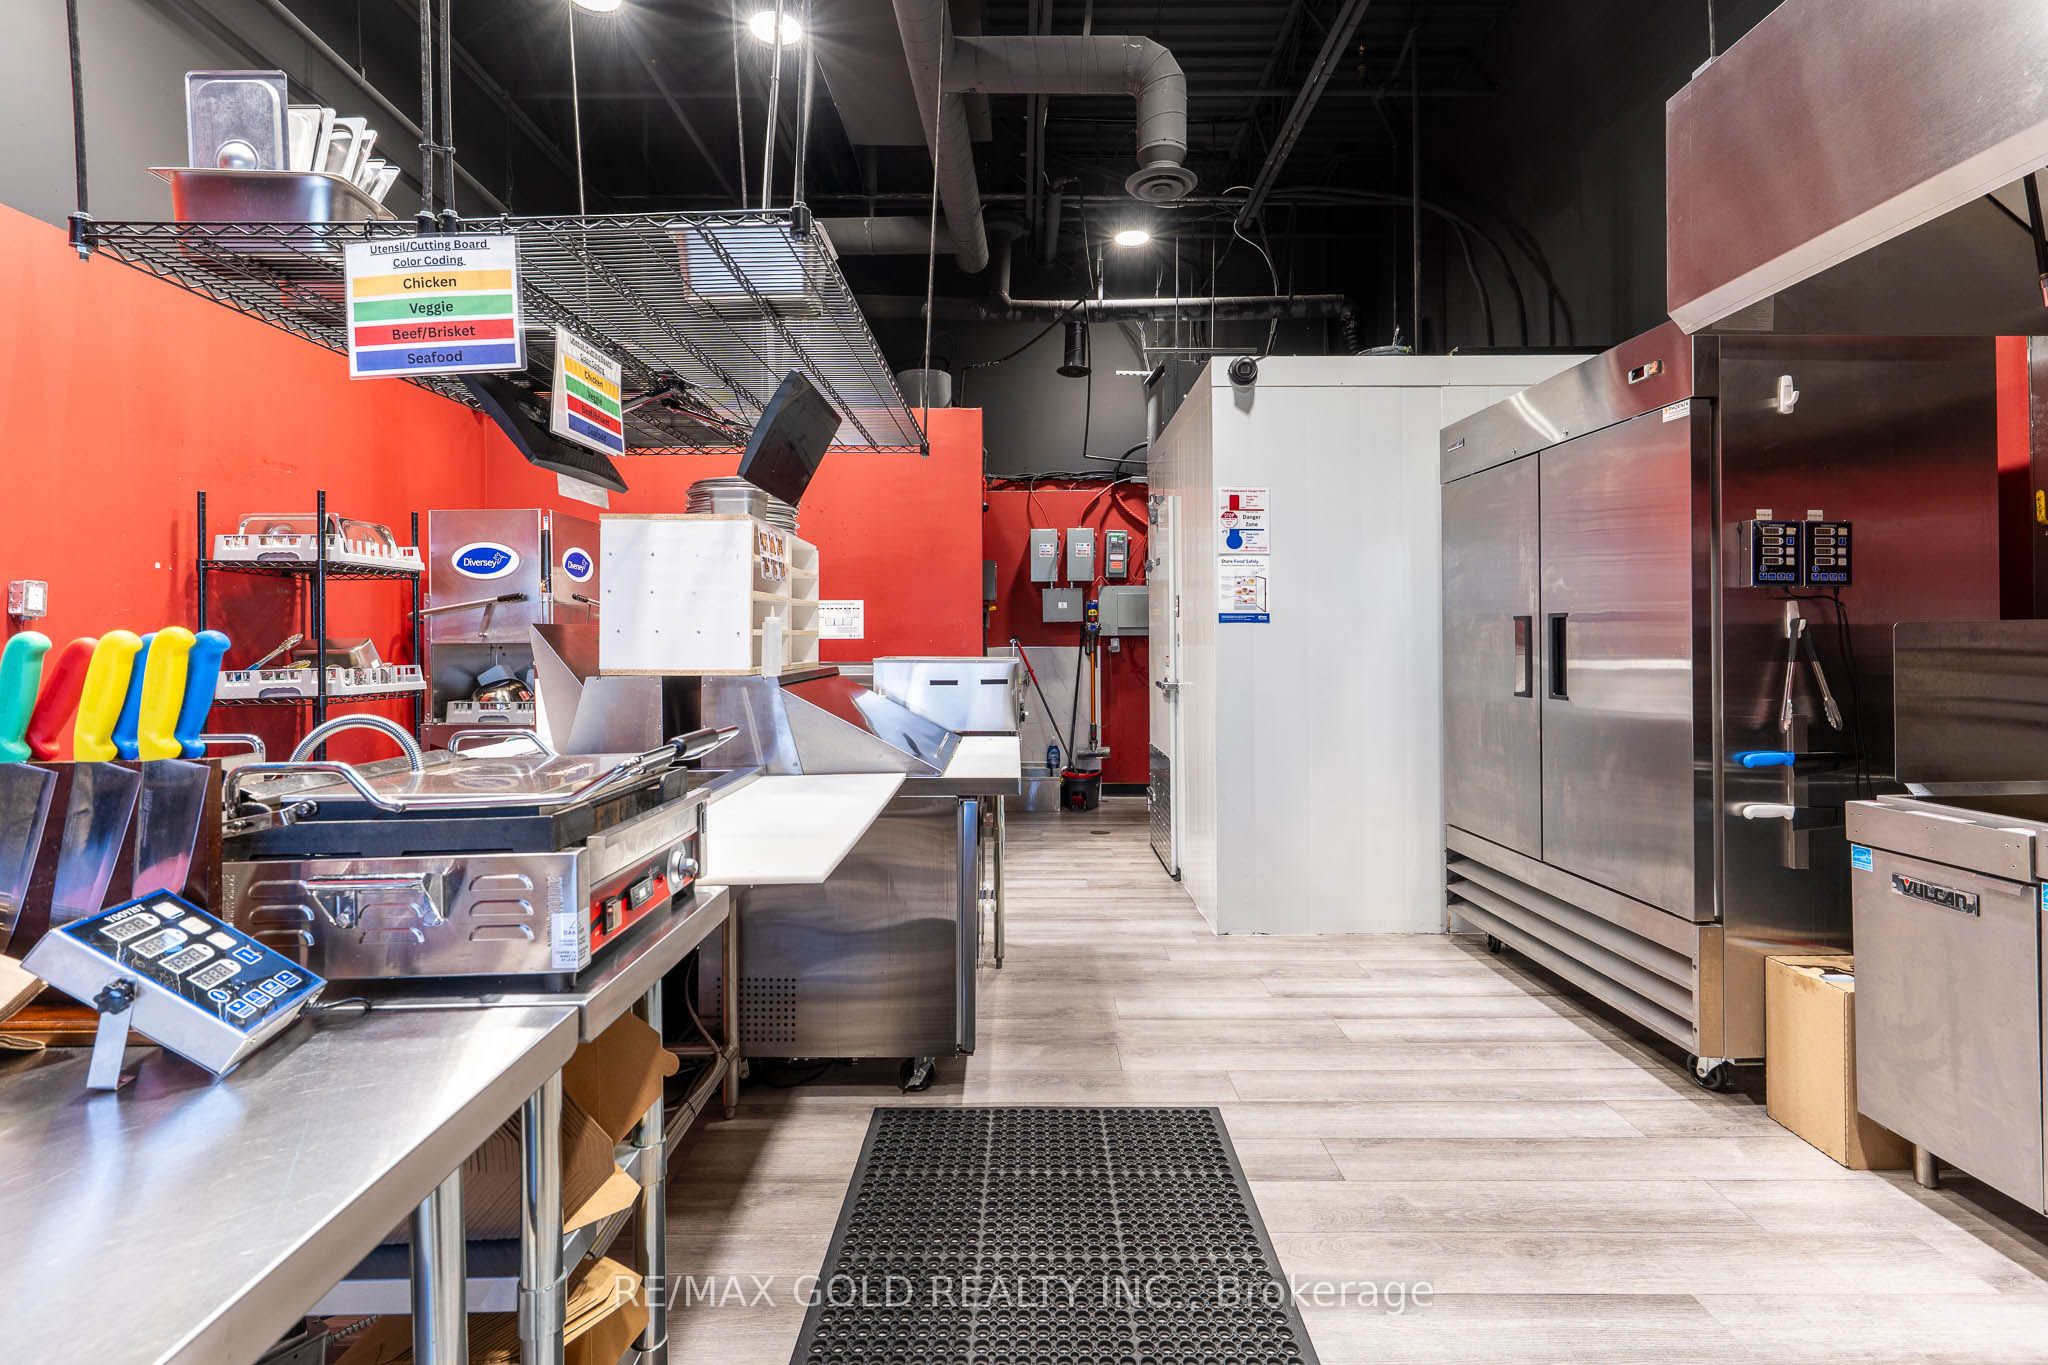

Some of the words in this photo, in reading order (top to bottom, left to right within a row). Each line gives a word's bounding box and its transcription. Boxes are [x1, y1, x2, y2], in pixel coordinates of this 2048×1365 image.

[370, 240, 451, 255] Utensil/Cutting
[453, 239, 488, 250] Board
[393, 257, 421, 268] Color
[424, 255, 464, 267] Coding
[403, 276, 457, 289] Chicken
[409, 302, 454, 315] Veggie
[392, 326, 476, 341] Beef/Brisket
[407, 350, 463, 364] Seafood
[463, 557, 496, 569] Diversey
[567, 560, 584, 573] Diversey
[1901, 877, 1967, 910] VULCAN
